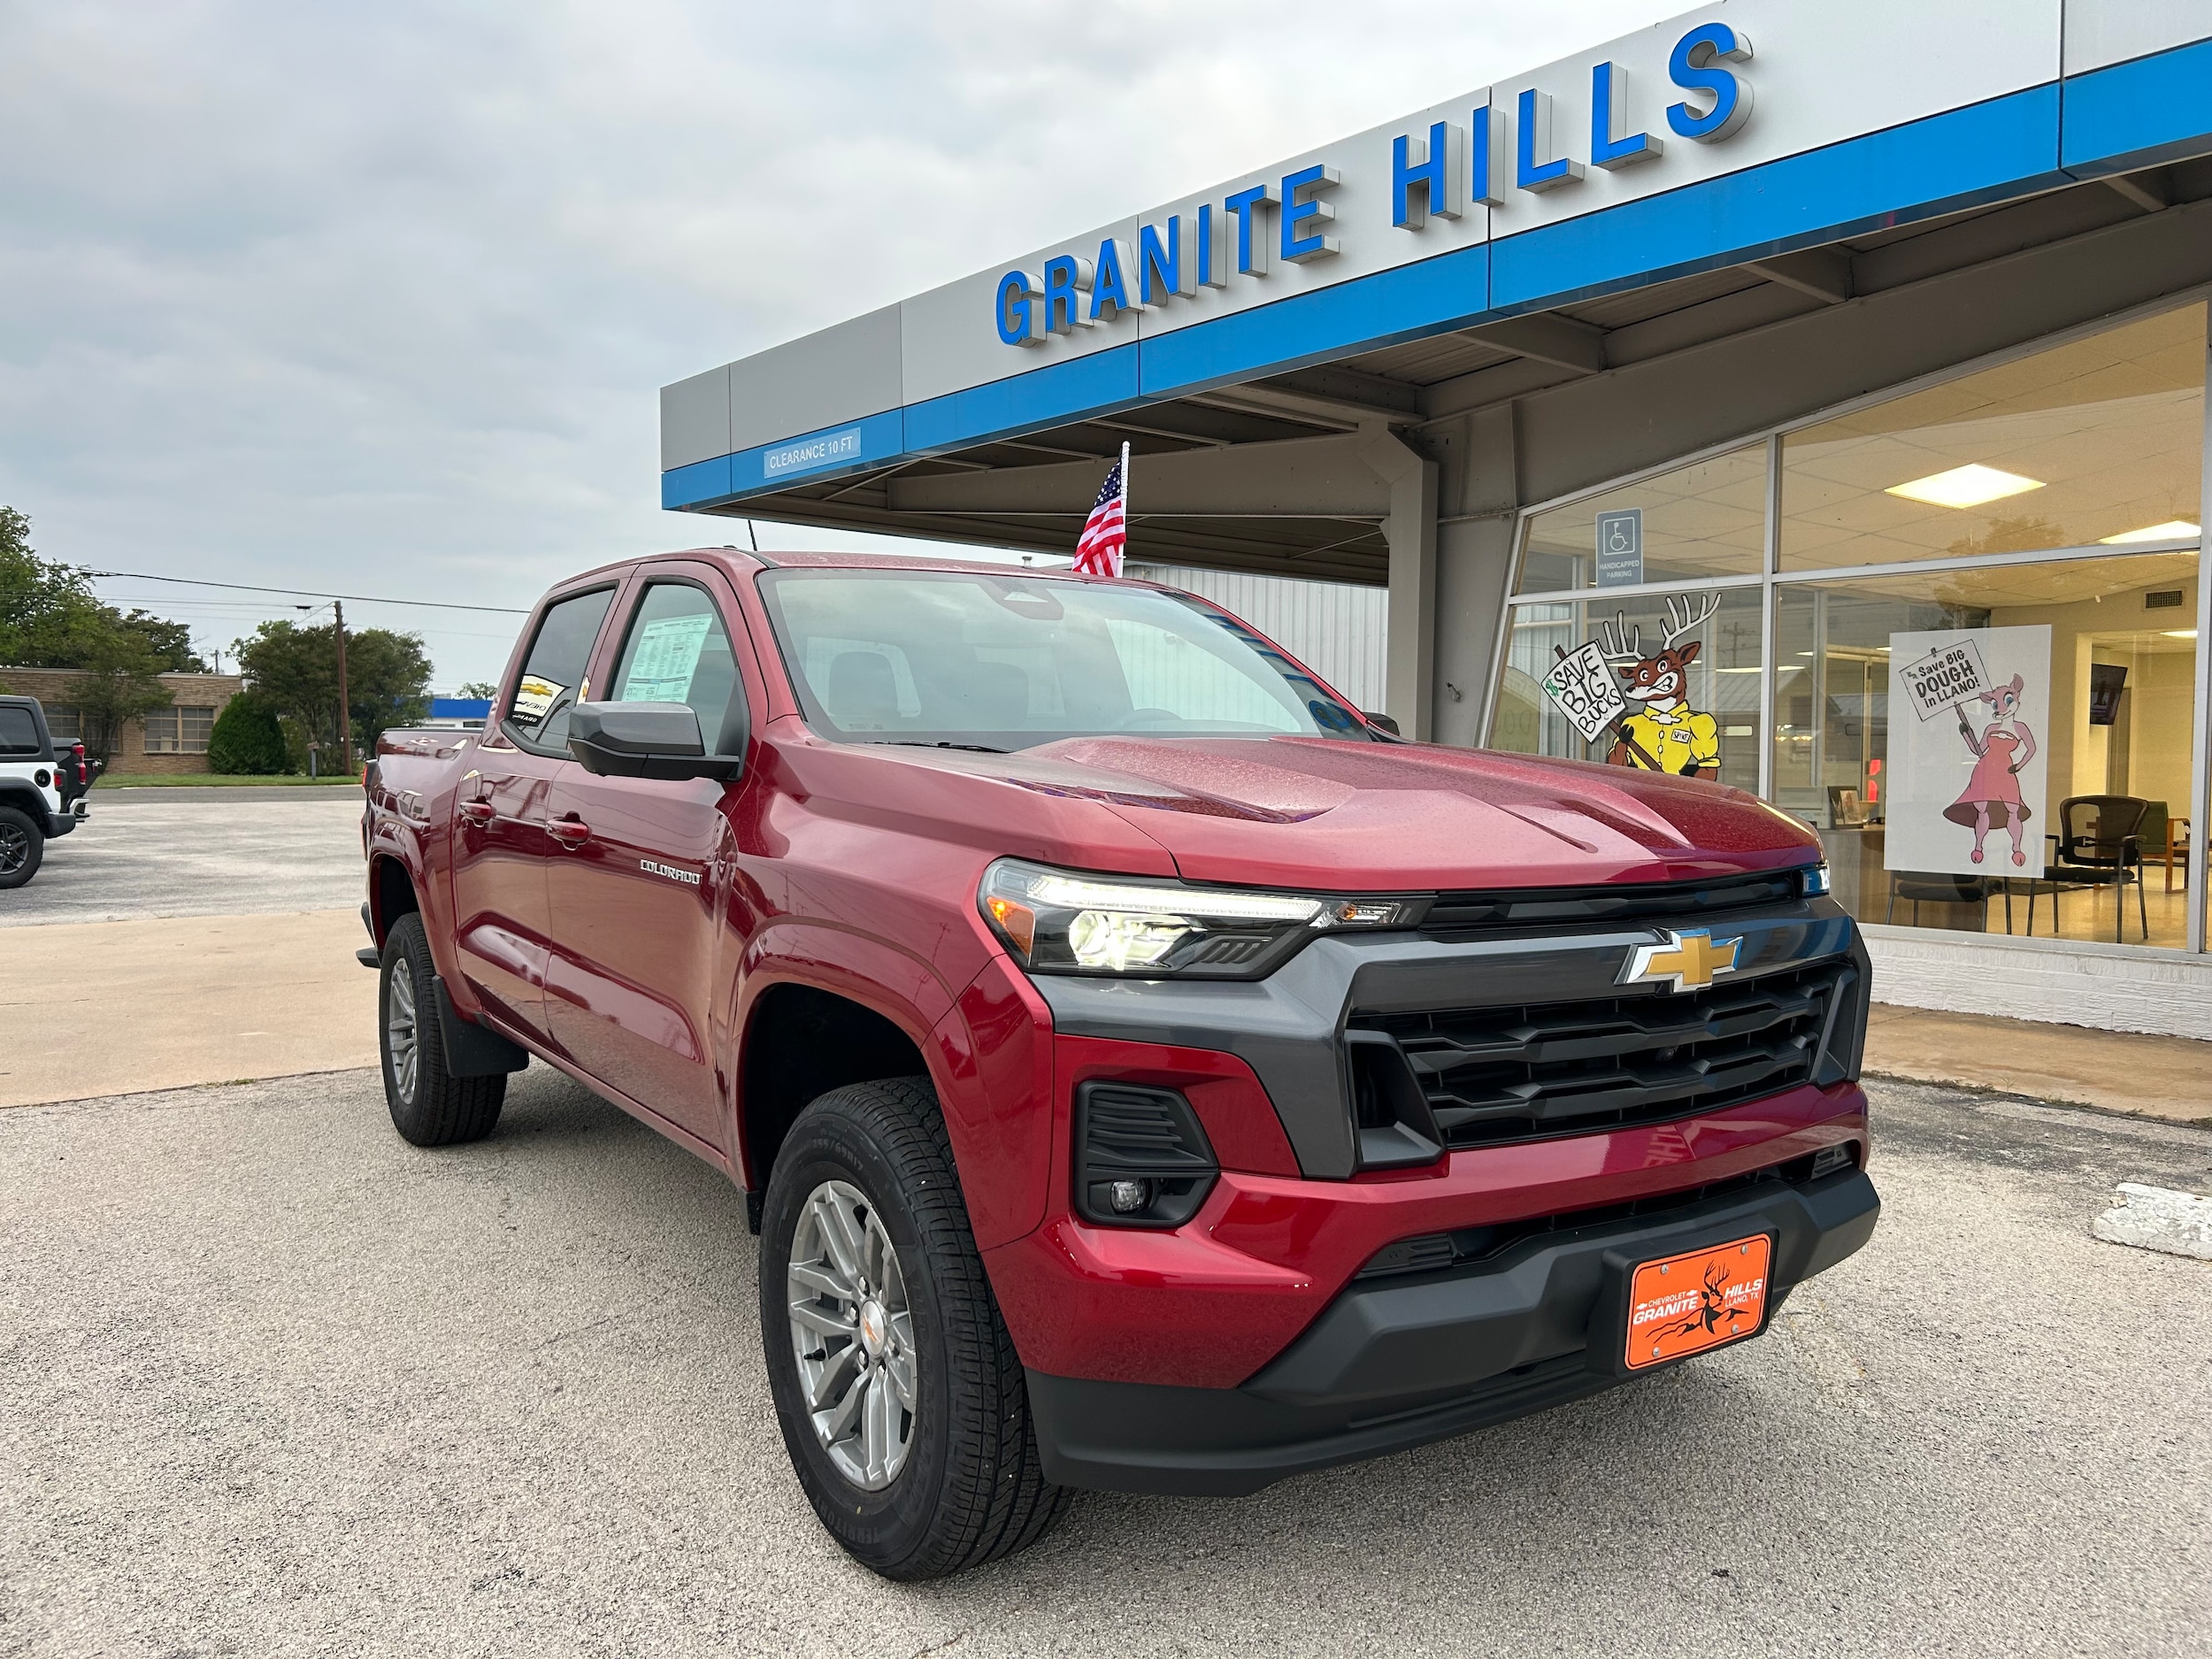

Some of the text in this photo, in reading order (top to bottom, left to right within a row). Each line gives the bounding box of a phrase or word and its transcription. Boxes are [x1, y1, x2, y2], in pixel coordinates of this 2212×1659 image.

[995, 22, 1754, 348] GRANITE HILLS
[770, 436, 853, 469] CLEARANCE 10 FT
[1599, 559, 1640, 570] HANDICAPPED
[1606, 570, 1632, 579] PARKING
[1915, 659, 1974, 698] DOUGH
[1918, 660, 1945, 677] Save
[1946, 649, 1964, 664] BIG
[1562, 672, 1607, 714] BIG
[1924, 675, 1980, 708] in LLANO!
[1578, 688, 1622, 733] BUCKS
[640, 859, 701, 885] COLORADO
[1632, 1279, 1763, 1325] GRANITE HILLS
[1647, 1291, 1686, 1308] CHEVROLET
[1724, 1291, 1759, 1308] LLANO, TX
